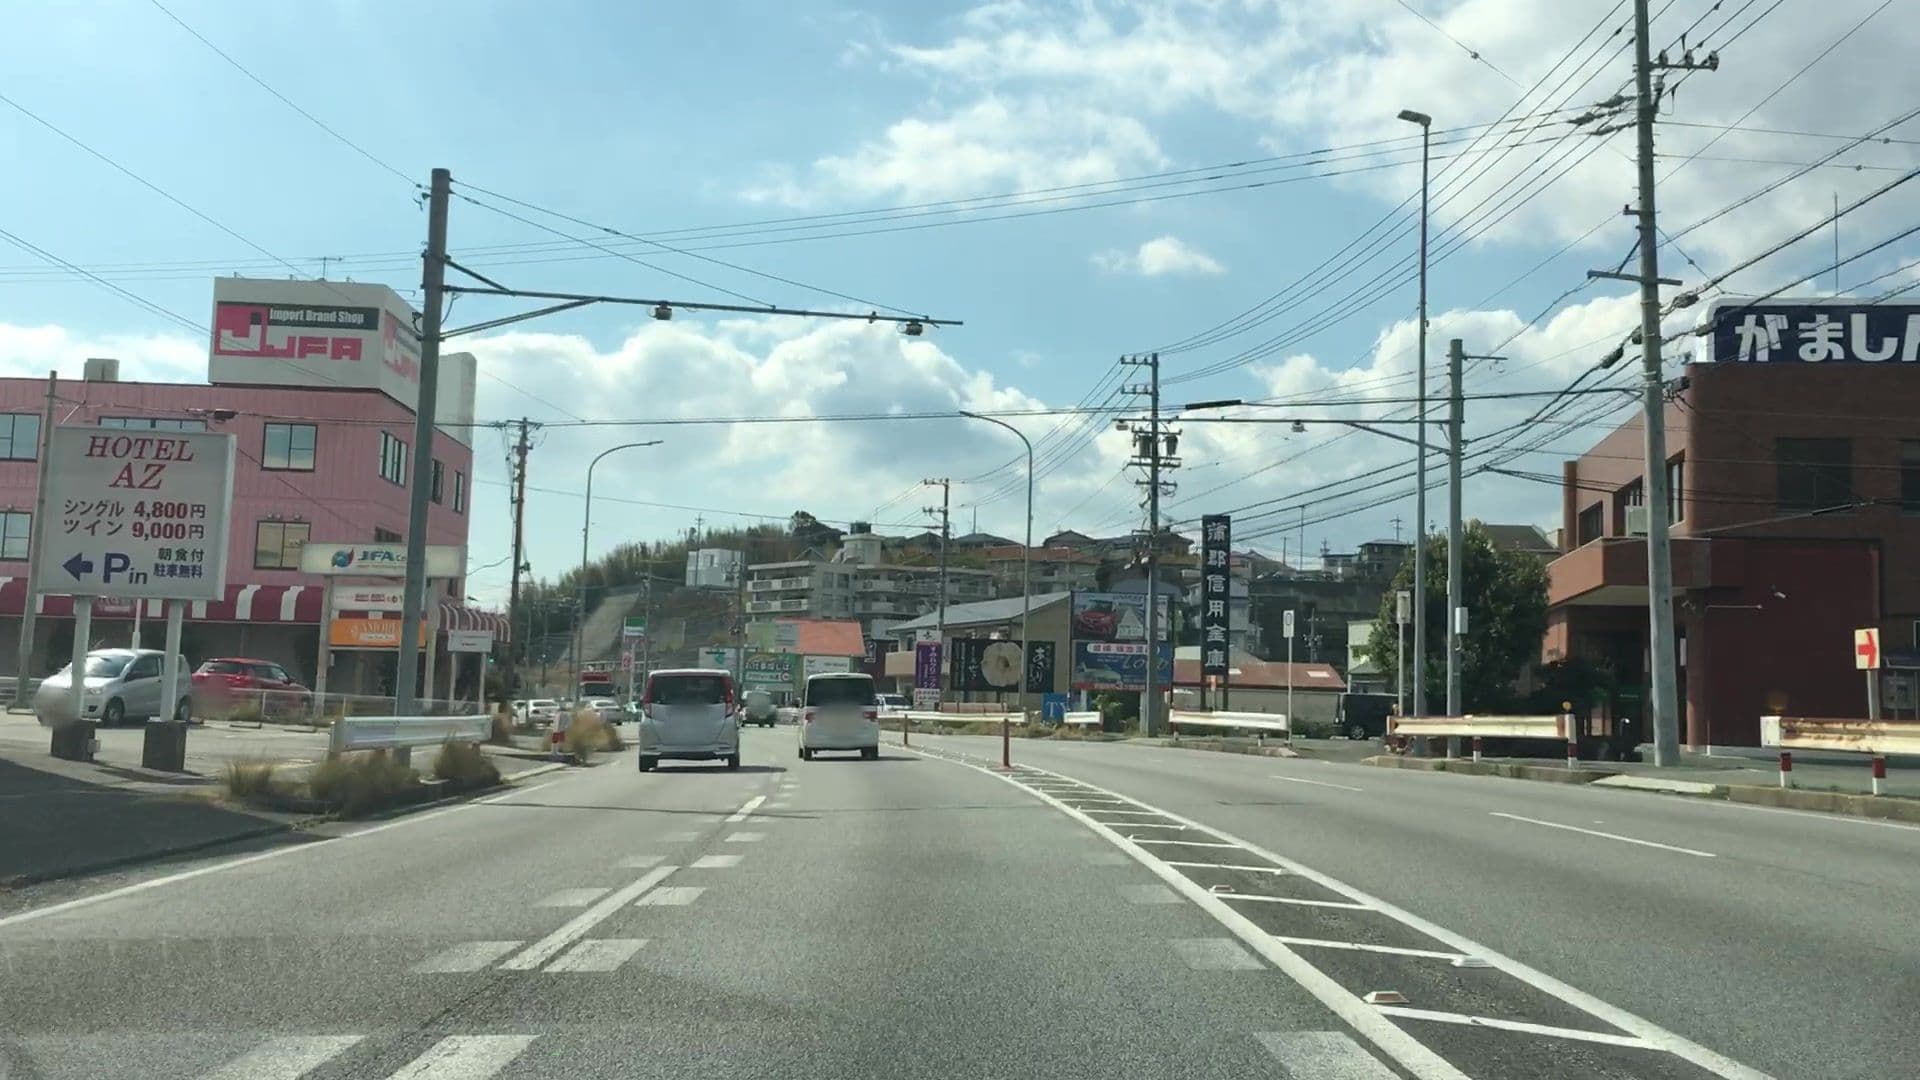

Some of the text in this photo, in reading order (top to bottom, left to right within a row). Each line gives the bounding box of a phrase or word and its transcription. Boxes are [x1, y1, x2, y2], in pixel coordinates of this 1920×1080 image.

[270, 308, 365, 325] Import Brand Shop
[85, 435, 194, 462] HOTEL
[108, 462, 166, 490] AZ
[64, 499, 125, 518] シングル
[63, 519, 124, 537] ツイン
[157, 548, 204, 563] 朝食付
[153, 563, 203, 579] 駐車無料
[1204, 521, 1228, 667] 蒲郡信用金庫
